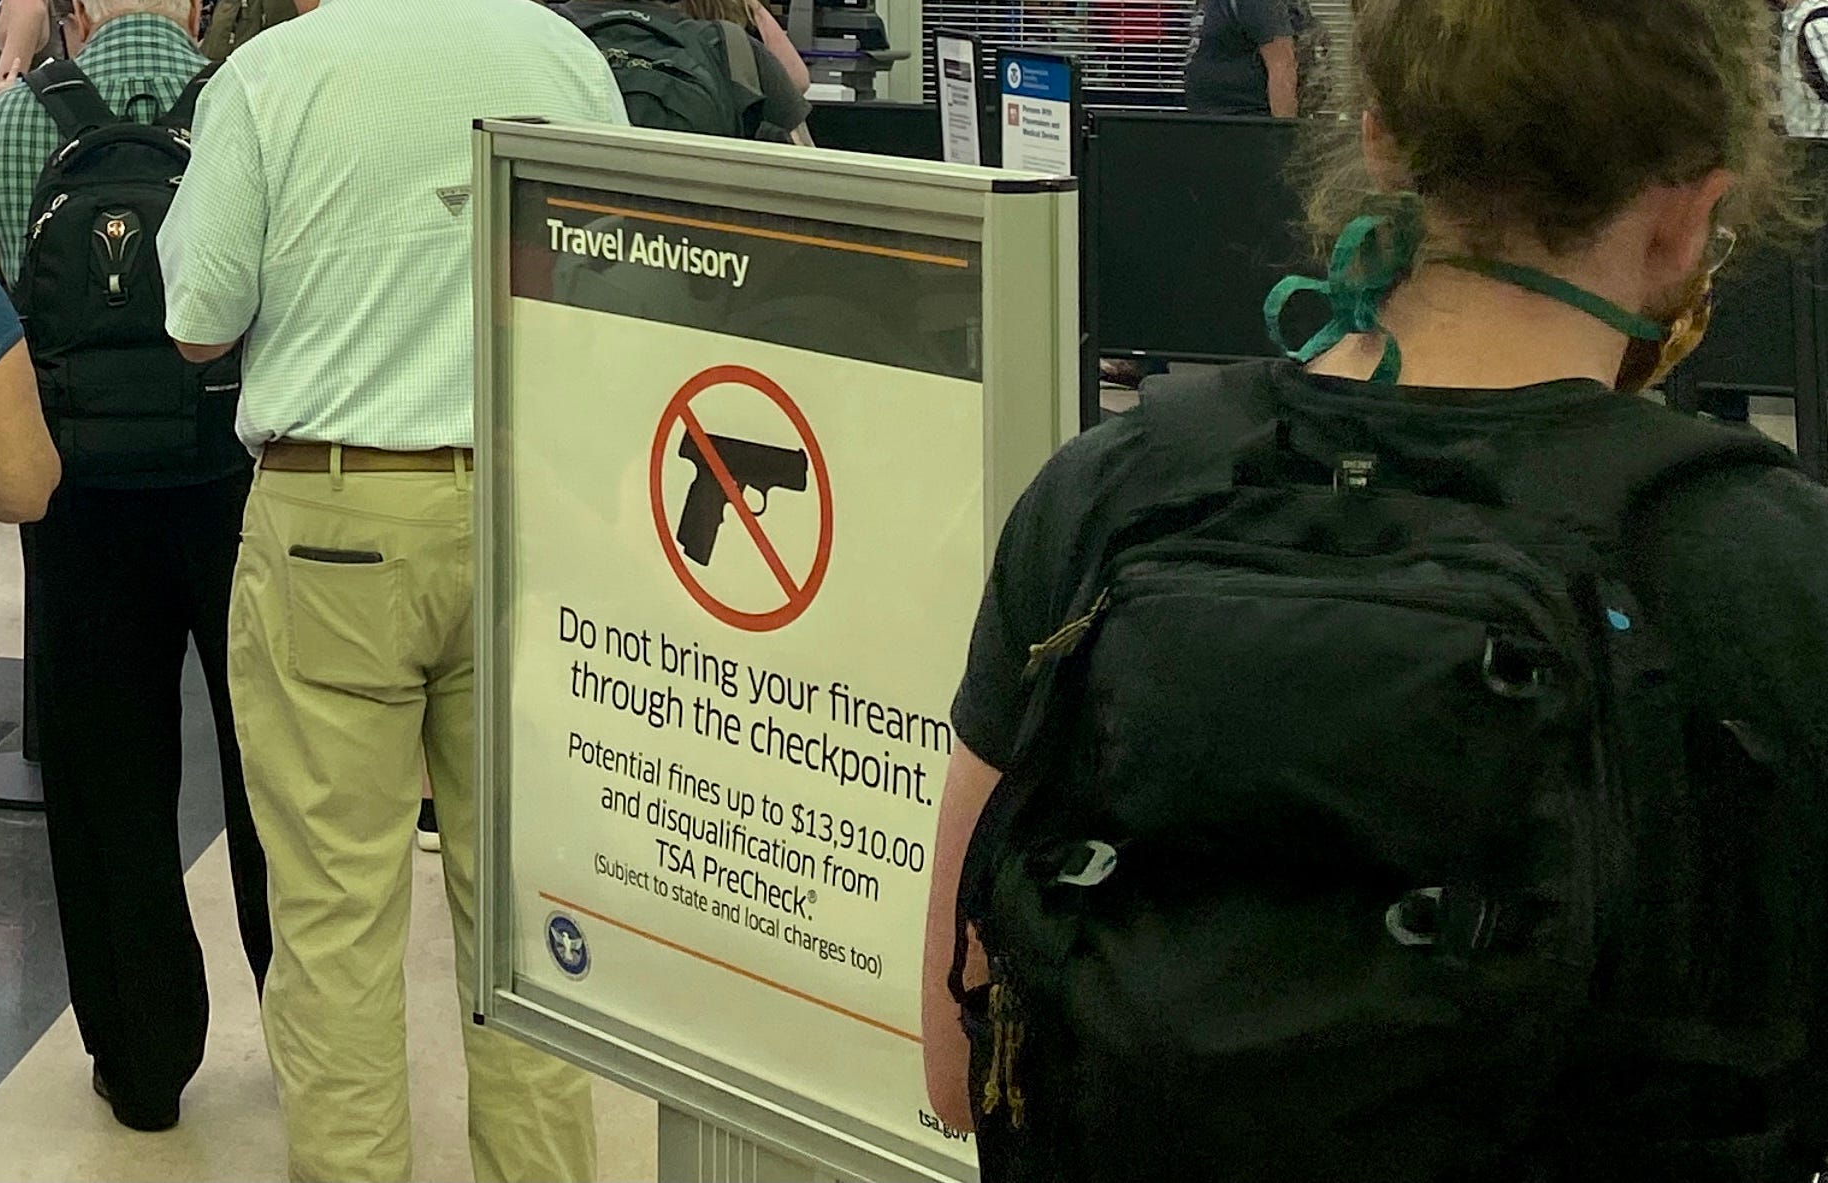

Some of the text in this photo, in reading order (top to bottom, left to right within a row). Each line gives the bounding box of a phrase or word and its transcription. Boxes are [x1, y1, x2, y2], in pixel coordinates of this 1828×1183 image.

[546, 218, 749, 288] Travel Advisory
[560, 606, 951, 755] Do not bring your firearm
[571, 660, 932, 806] through the checkpoint.
[568, 731, 925, 873] Potential fines up to $13,910.00
[601, 787, 880, 902] and disqualification from
[655, 838, 696, 880] TSA
[594, 852, 883, 979] (Subject to state and local charges too)
